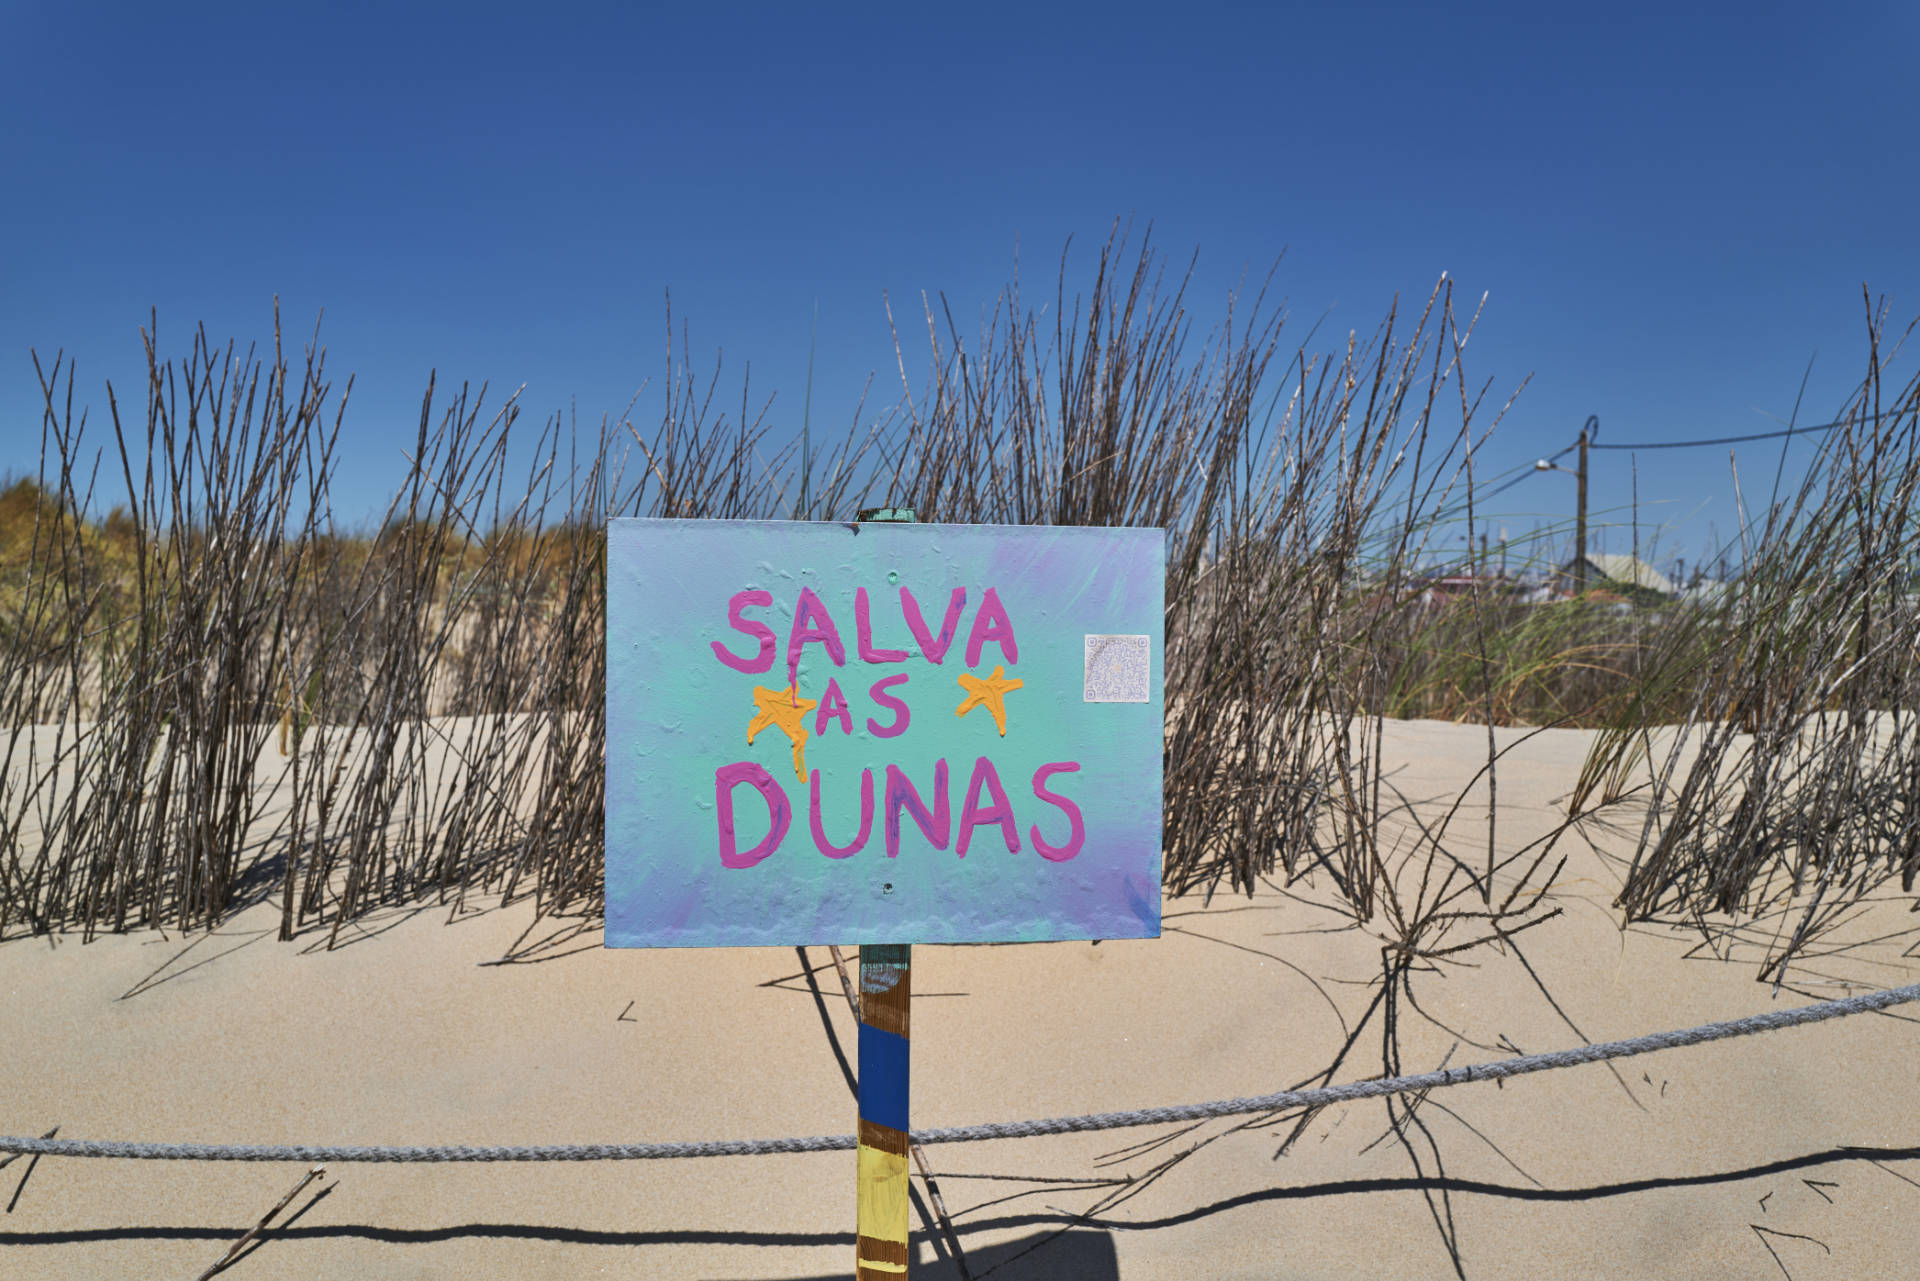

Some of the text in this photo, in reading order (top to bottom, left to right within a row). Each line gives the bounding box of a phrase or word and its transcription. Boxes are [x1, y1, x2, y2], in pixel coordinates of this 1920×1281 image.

[710, 585, 1019, 675] SALVA
[815, 673, 911, 738] AS
[715, 756, 1086, 869] DUNAS
